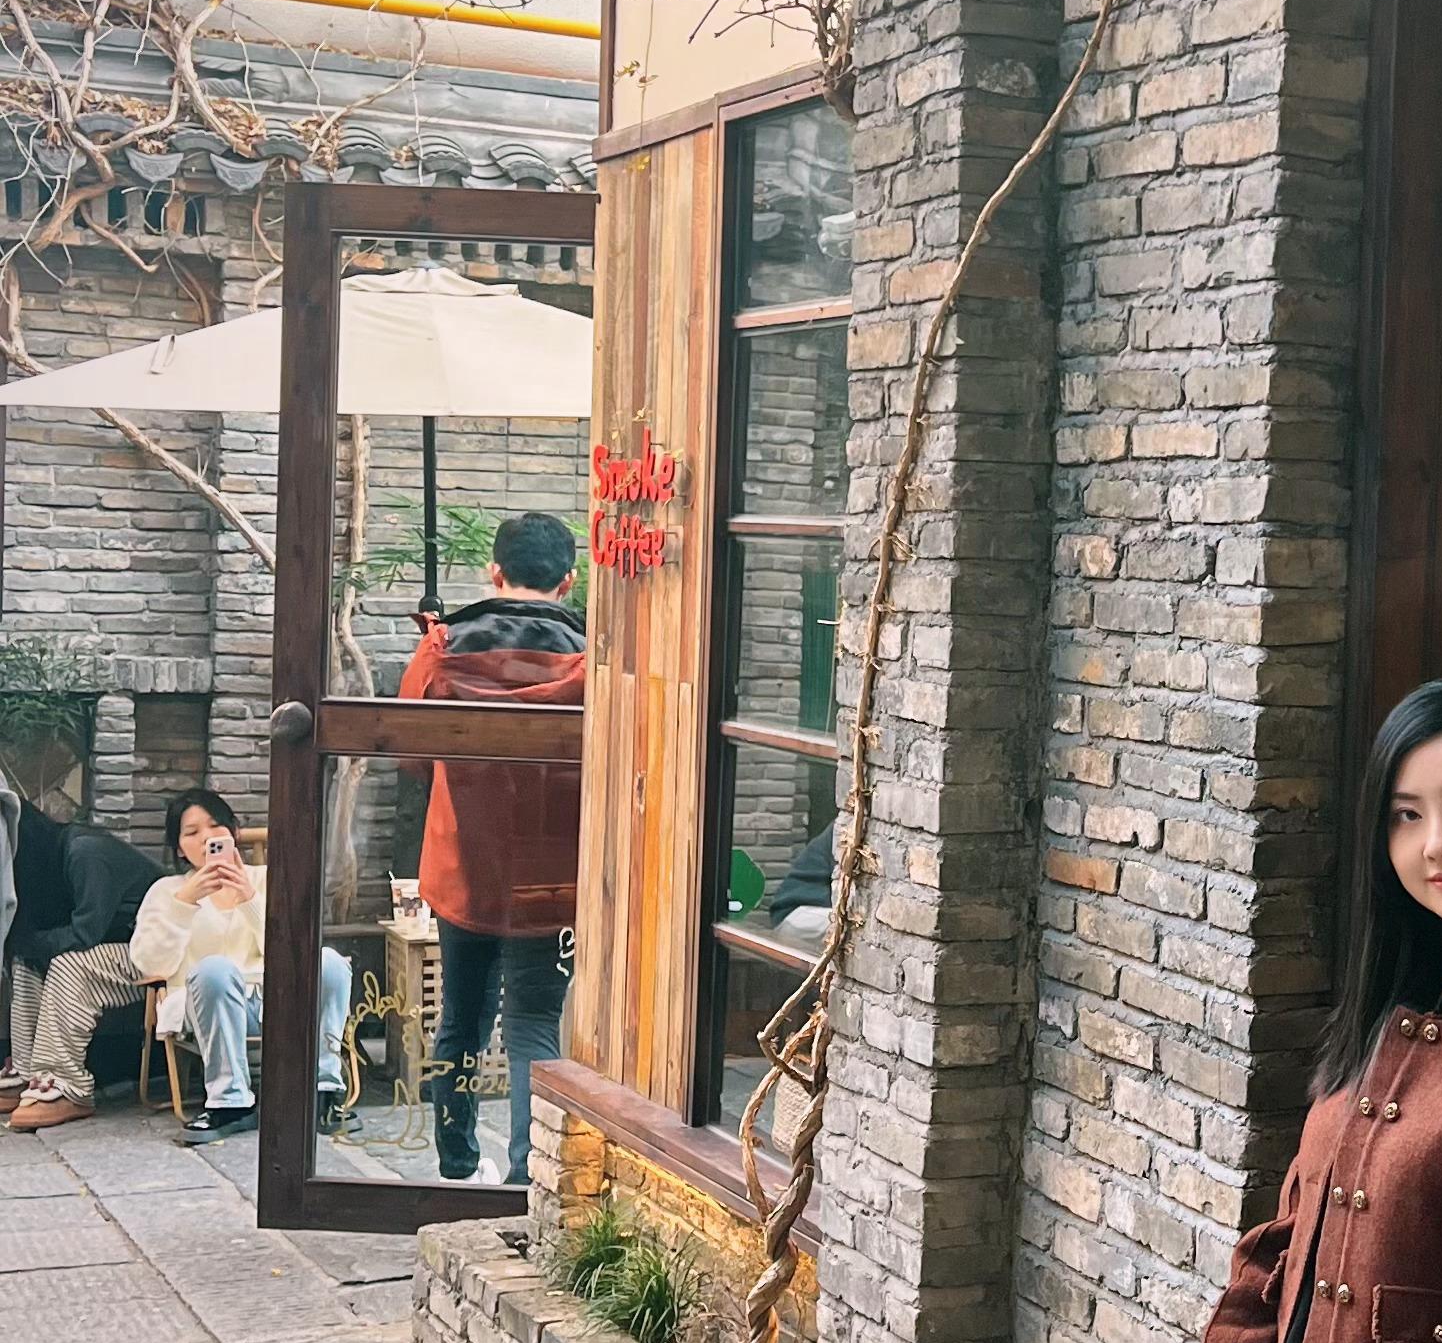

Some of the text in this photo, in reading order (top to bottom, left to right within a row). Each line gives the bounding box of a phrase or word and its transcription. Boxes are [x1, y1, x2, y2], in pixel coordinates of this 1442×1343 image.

[593, 427, 675, 502] Smoke
[592, 509, 665, 579] Coffee
[454, 1075, 512, 1096] 2024
